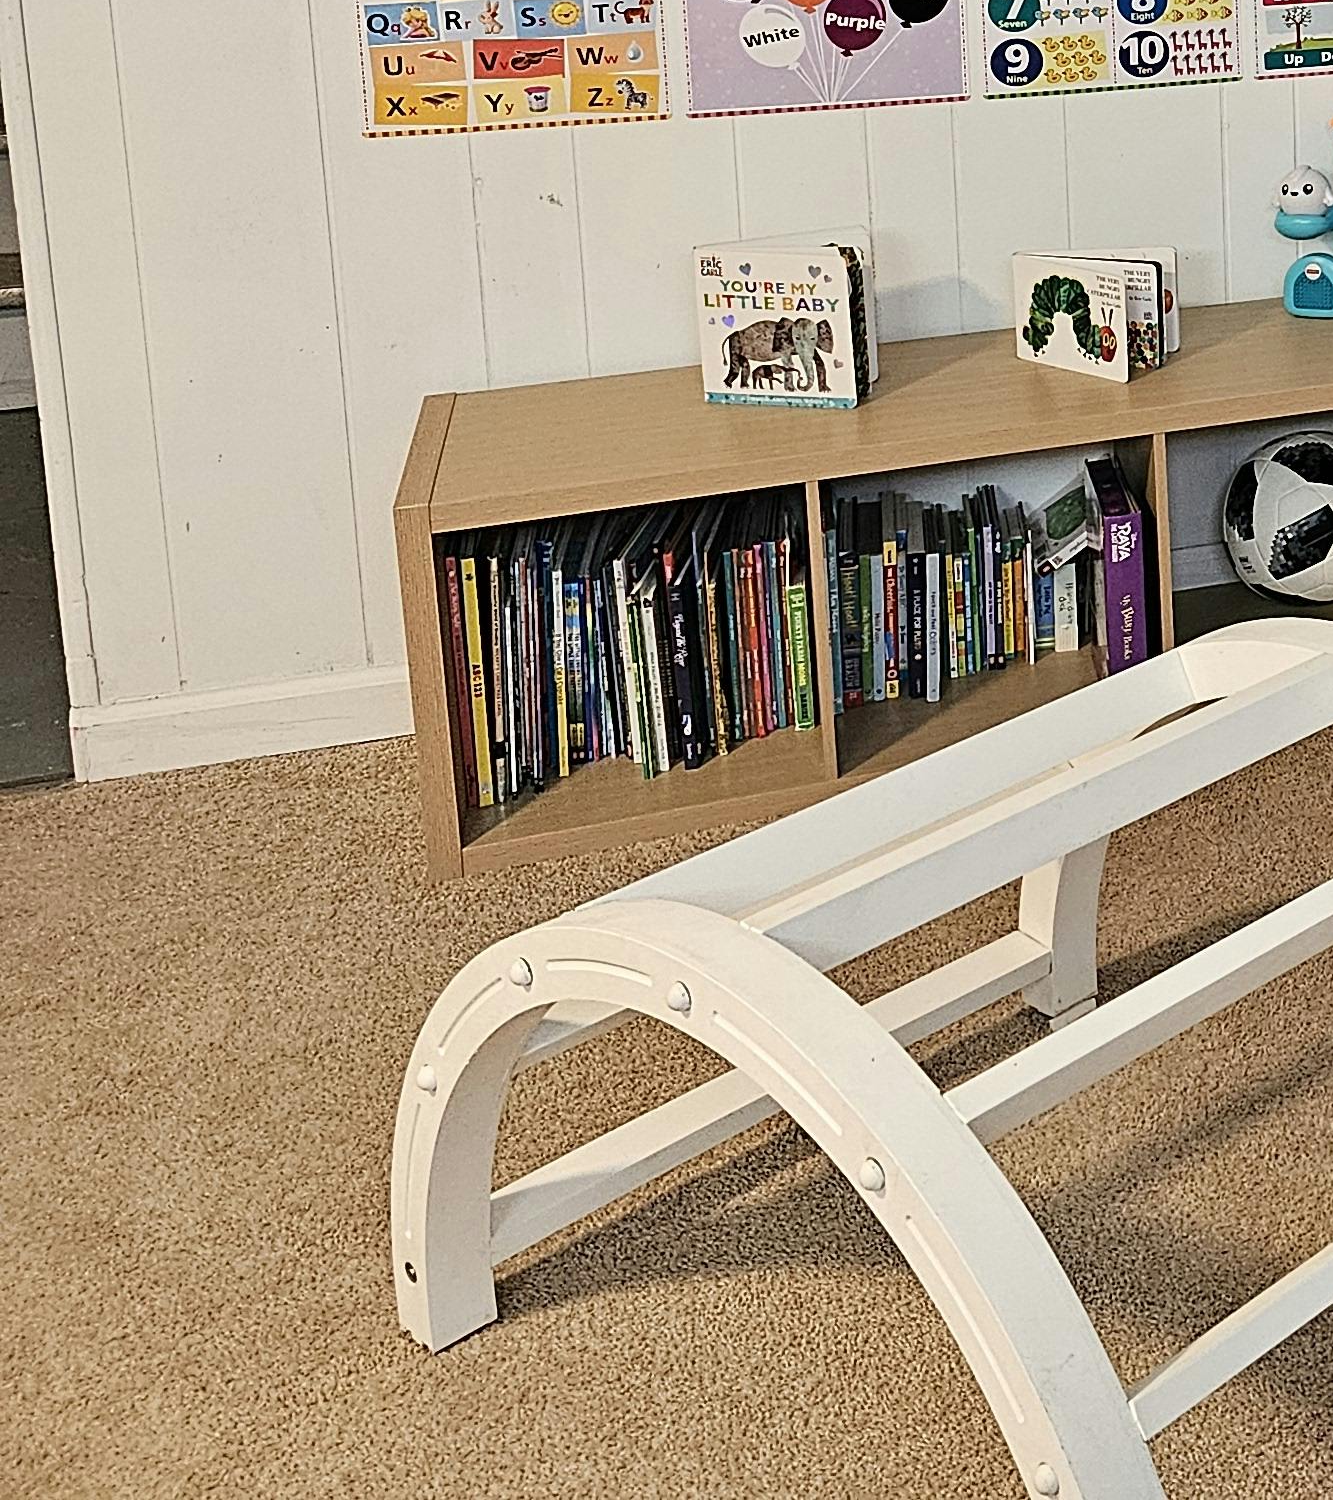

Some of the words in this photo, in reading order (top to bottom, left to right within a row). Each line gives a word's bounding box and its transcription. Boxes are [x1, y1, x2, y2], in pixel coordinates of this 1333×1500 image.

[826, 13, 886, 31] Purple
[743, 28, 799, 47] White
[1122, 37, 1163, 65] 10
[720, 280, 785, 294] YOU'RE
[792, 283, 816, 295] MY
[704, 294, 775, 310] LITTLE
[782, 297, 839, 312] BABY
[1118, 522, 1131, 562] RAYA
